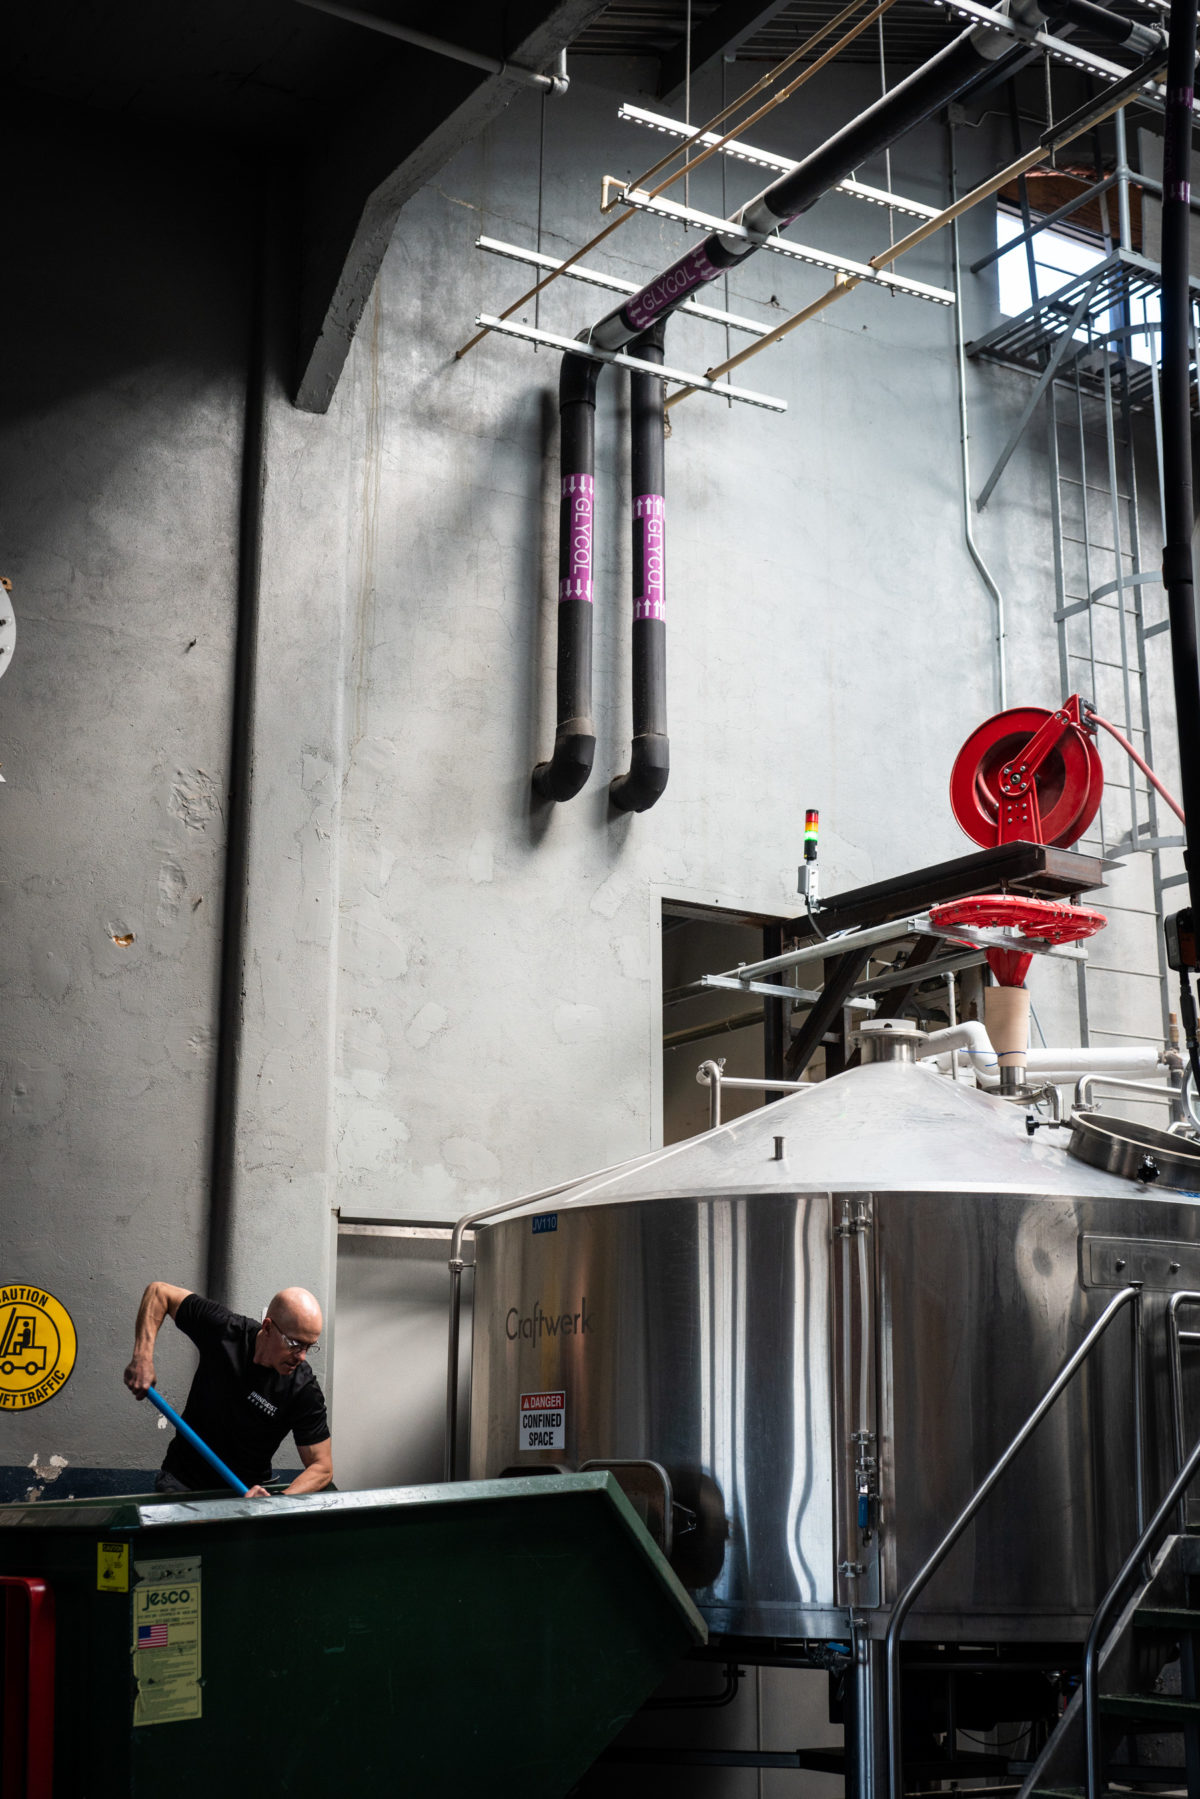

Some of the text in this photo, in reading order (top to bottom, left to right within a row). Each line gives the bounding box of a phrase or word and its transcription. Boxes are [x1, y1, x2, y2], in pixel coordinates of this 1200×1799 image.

[642, 266, 696, 311] GLYCOL
[573, 497, 591, 575] GLYCOL
[647, 519, 663, 595] GLYCOL
[532, 1216, 558, 1232] JV110
[0, 1288, 49, 1308] AUTION
[505, 1297, 597, 1348] Craftwerk
[20, 1370, 66, 1406] TRAFFIC
[530, 1395, 562, 1408] DANGER
[522, 1413, 562, 1429] CONFINED
[528, 1431, 554, 1446] SPACE
[142, 1590, 190, 1611] jesco
